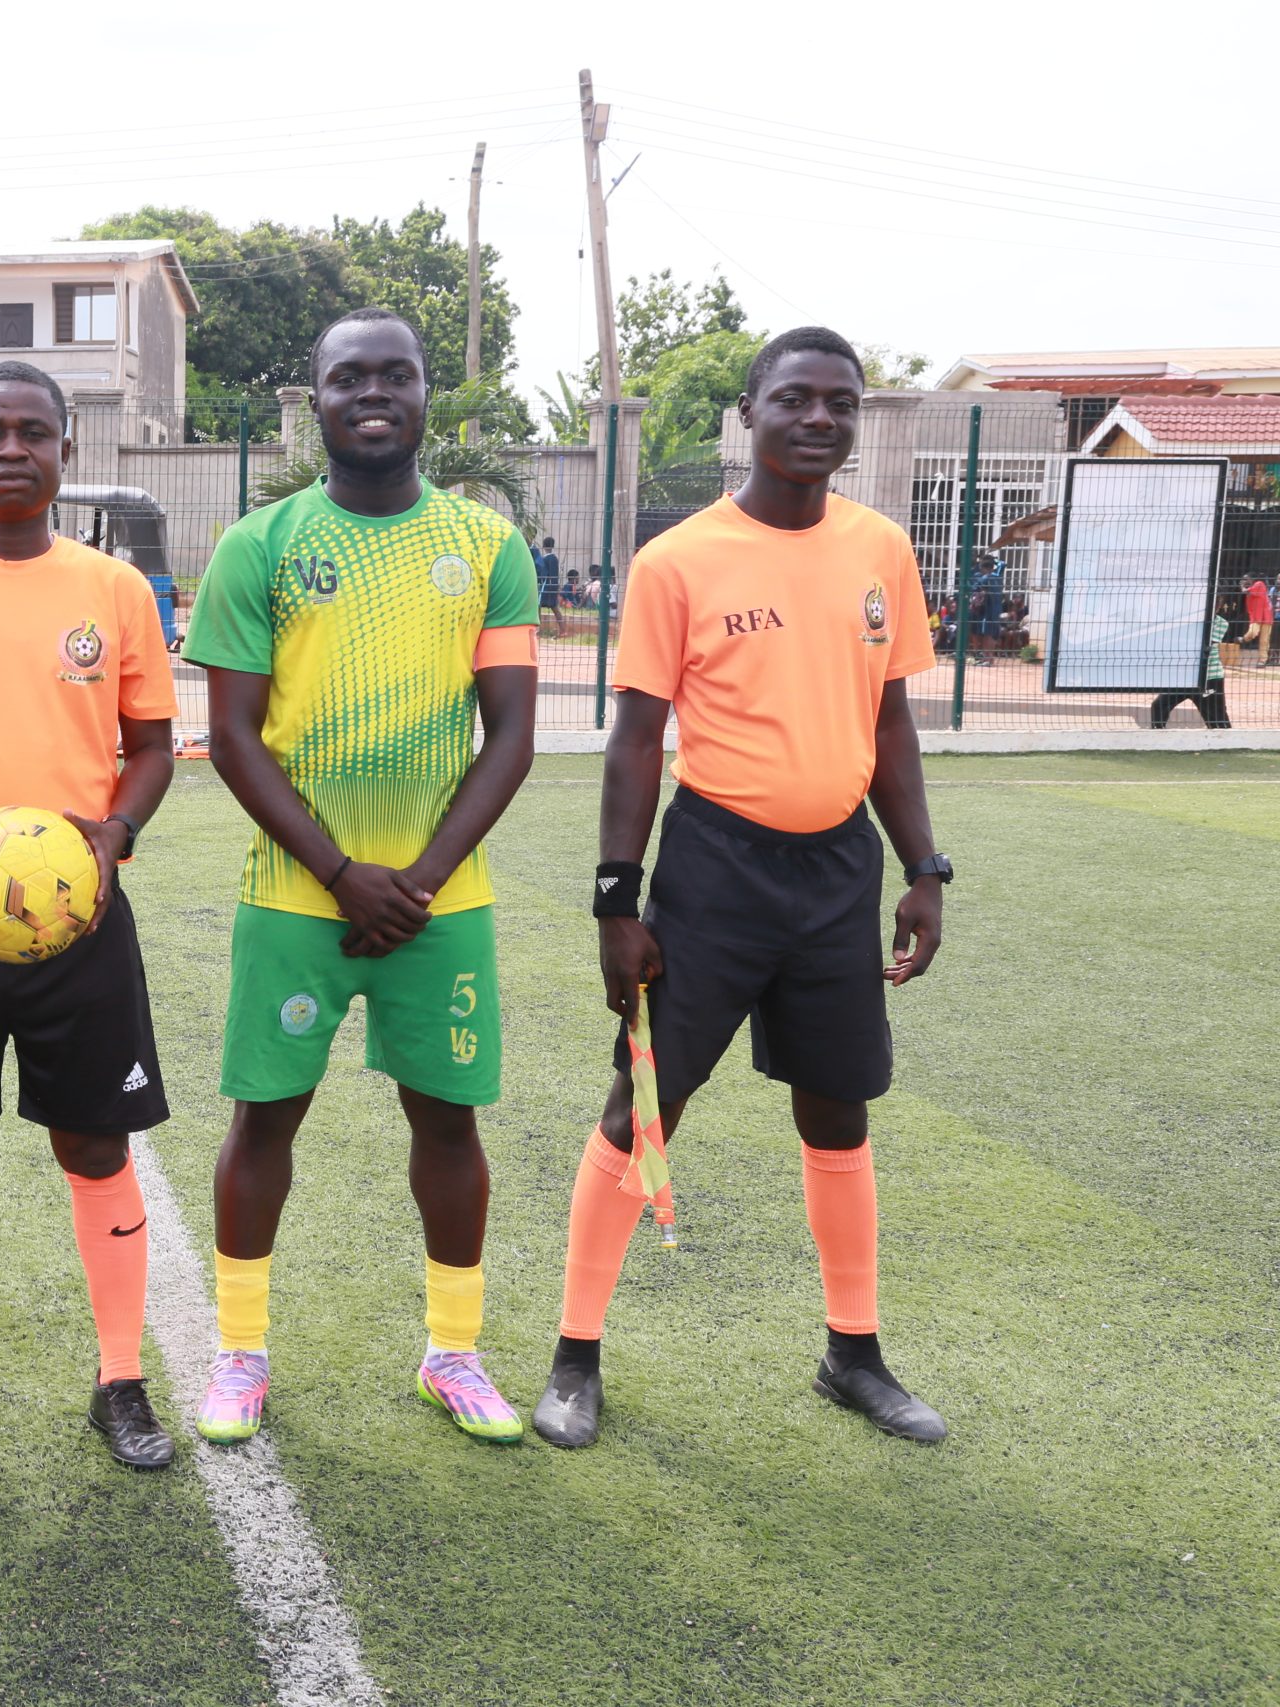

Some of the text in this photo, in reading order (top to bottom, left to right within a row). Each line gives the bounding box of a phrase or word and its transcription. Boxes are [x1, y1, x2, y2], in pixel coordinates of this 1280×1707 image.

[293, 555, 338, 595] VG
[720, 607, 785, 637] RFA
[448, 973, 477, 1018] 5
[450, 1027, 478, 1059] VG
[123, 1075, 149, 1092] adidas
